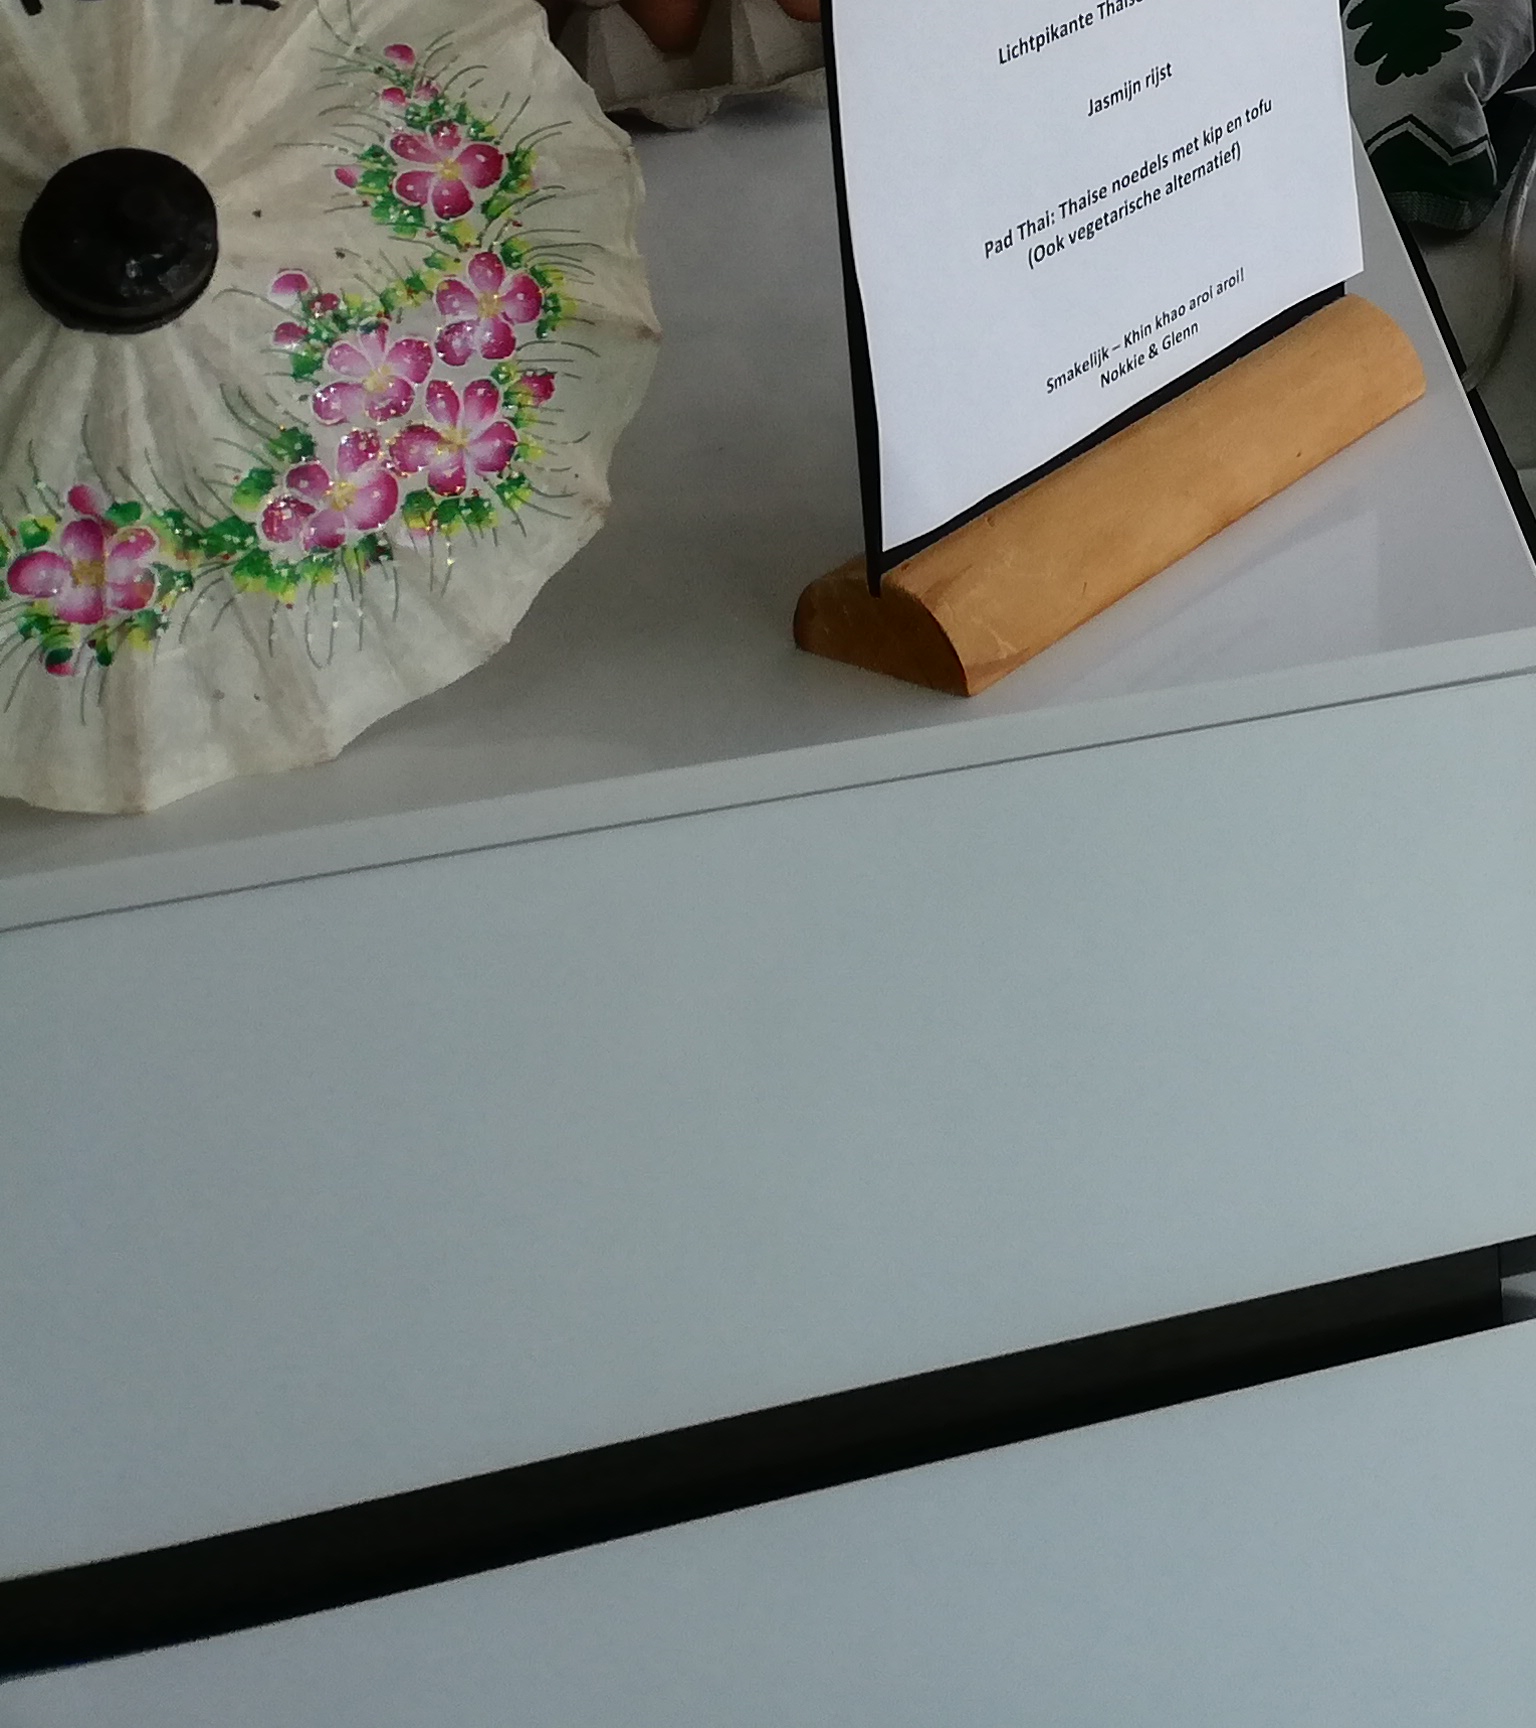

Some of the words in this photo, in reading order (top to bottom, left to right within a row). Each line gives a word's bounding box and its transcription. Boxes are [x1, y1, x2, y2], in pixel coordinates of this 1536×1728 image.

[998, 10, 1094, 65] Lichtpikante
[1088, 77, 1142, 117] Jasmijn
[1145, 62, 1173, 88] rijst
[984, 229, 1014, 259] Pad
[1017, 210, 1056, 241] Thai:
[1058, 185, 1108, 220] Thaise
[1111, 153, 1170, 195] noedels
[1172, 136, 1200, 164] met
[1202, 126, 1223, 147] kip
[1226, 115, 1243, 134] en
[1245, 98, 1272, 123] tofu
[1027, 235, 1065, 270] (Ook
[1068, 185, 1162, 245] vegetarische
[1165, 140, 1242, 196] alternatief)
[1046, 346, 1110, 394] Smakelijk
[1123, 322, 1152, 349] Khin
[1154, 304, 1186, 331] khao
[1189, 285, 1213, 311] aroi
[1216, 267, 1244, 296] aroi!
[1100, 352, 1145, 388] Nokkie
[1148, 343, 1159, 360] &
[1162, 322, 1199, 350] Glenn
